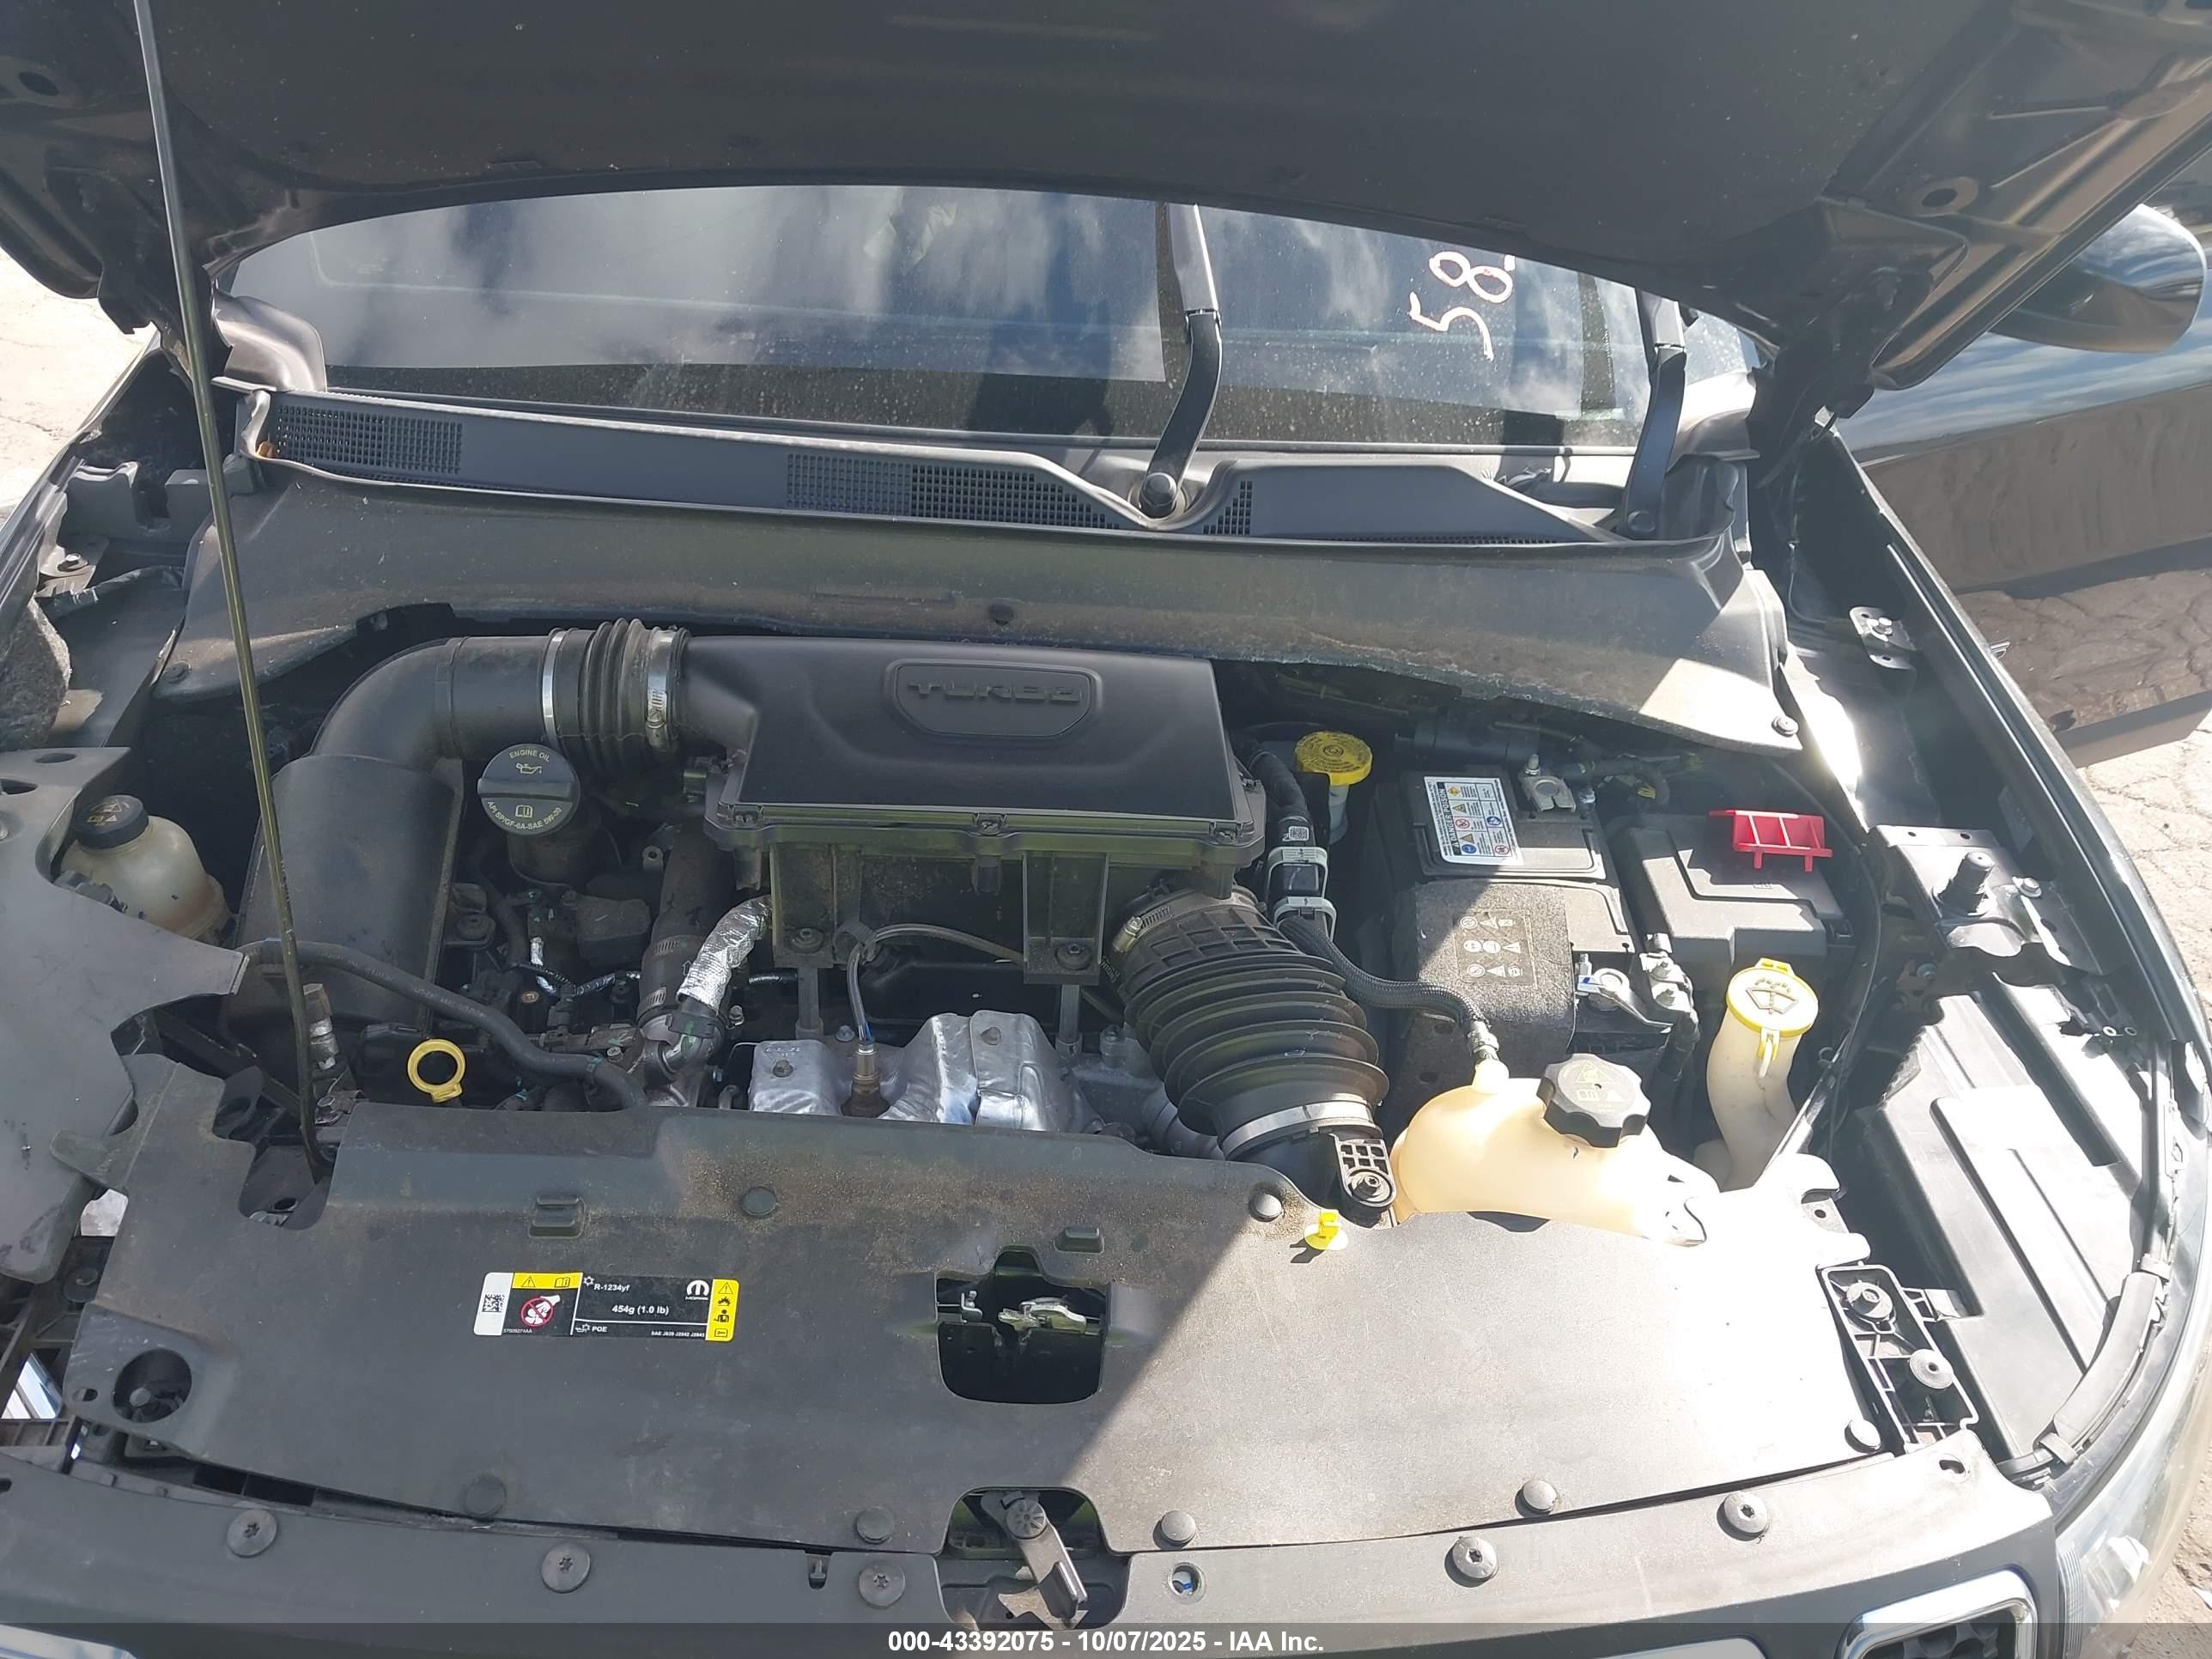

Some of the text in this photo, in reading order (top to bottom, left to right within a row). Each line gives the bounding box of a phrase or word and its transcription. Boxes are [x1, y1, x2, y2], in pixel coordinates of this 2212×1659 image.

[1407, 251, 1515, 362] 58
[509, 749, 550, 763] ENGINE OIL
[487, 801, 496, 813] API
[1437, 788, 1450, 812] POISON
[1444, 812, 1458, 842] DANGER
[593, 1283, 630, 1291] R-1234yf
[611, 1304, 670, 1315] 454g (1.0 lb)
